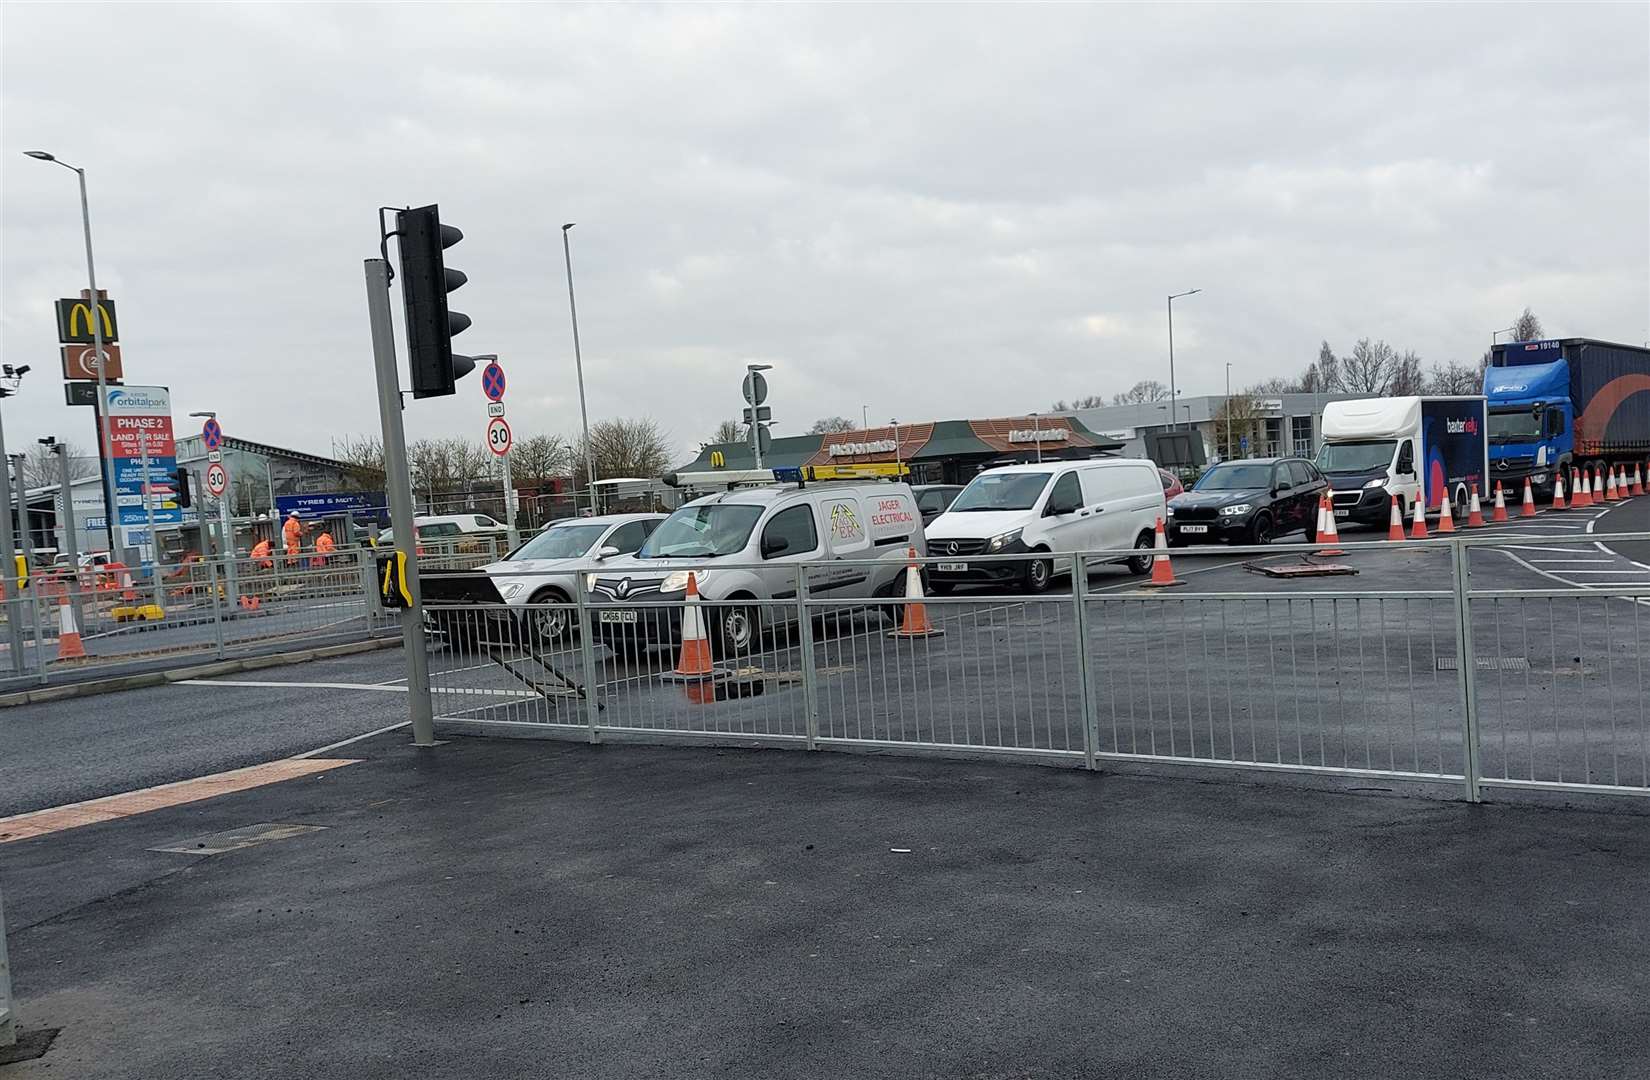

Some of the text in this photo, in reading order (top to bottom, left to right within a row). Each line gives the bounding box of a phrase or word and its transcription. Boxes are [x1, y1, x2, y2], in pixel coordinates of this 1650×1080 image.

[117, 418, 164, 429] PHASE 2
[111, 433, 170, 441] LAND FR SALE
[491, 428, 508, 444] 30
[209, 473, 224, 486] 30
[297, 498, 325, 506] TYRES
[878, 500, 899, 511] JAGER
[123, 514, 144, 522] 250m
[872, 512, 913, 525] ELECTRICAL
